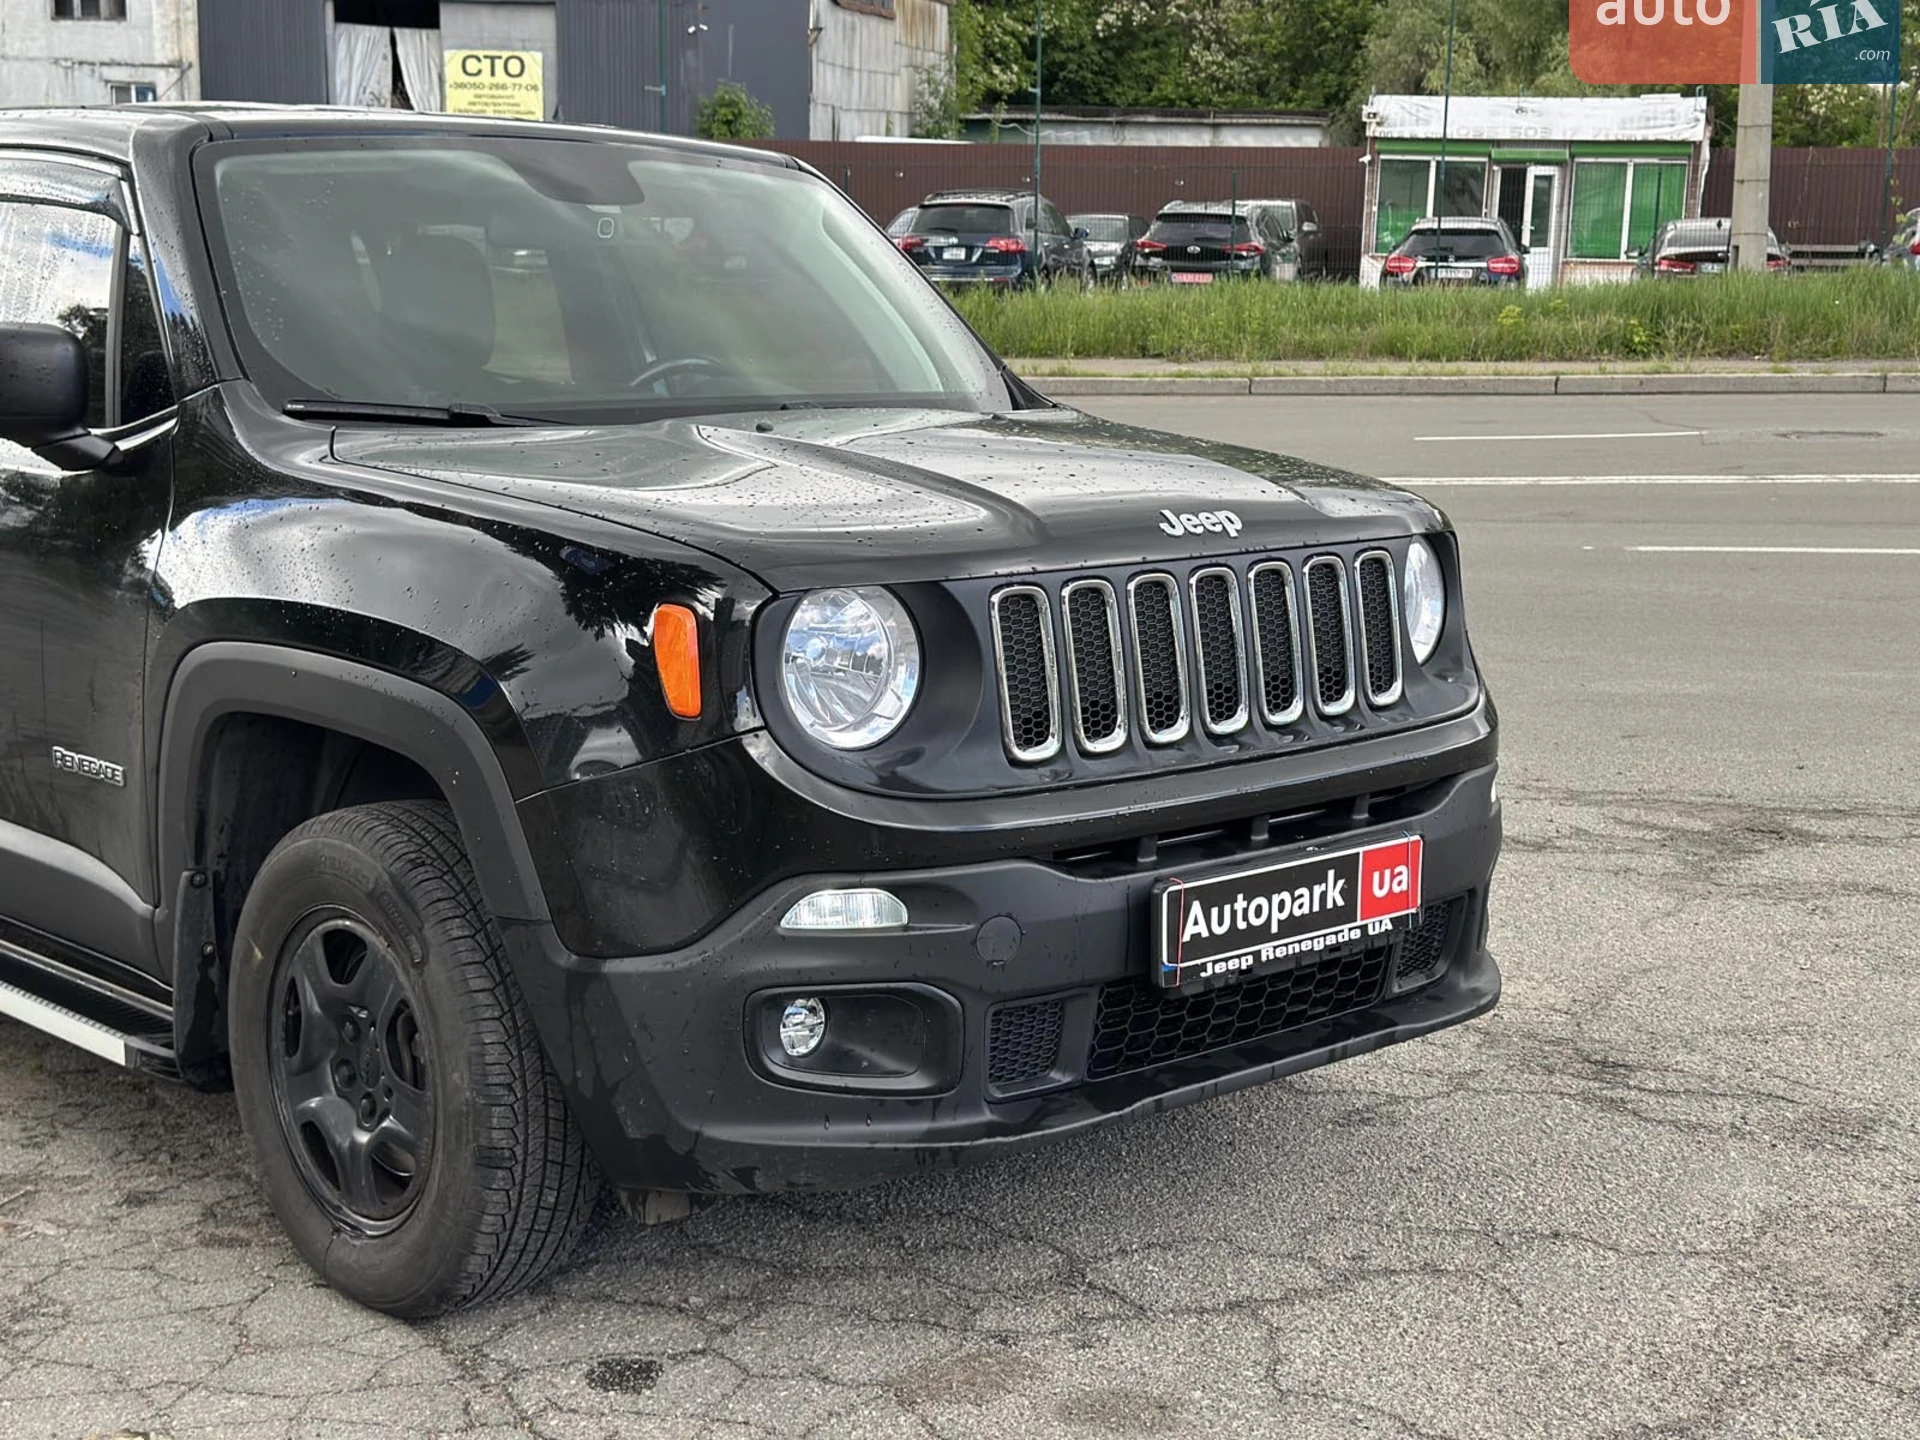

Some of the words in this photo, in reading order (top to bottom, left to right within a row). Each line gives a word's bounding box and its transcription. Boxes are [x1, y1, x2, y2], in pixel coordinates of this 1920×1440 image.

[461, 54, 526, 78] СТО
[1158, 509, 1243, 538] Jeep
[1182, 868, 1346, 943] Autopark
[1371, 864, 1409, 899] ua
[1200, 954, 1254, 979] Jeep
[1260, 926, 1362, 963] Renegade
[1367, 917, 1393, 936] UA
